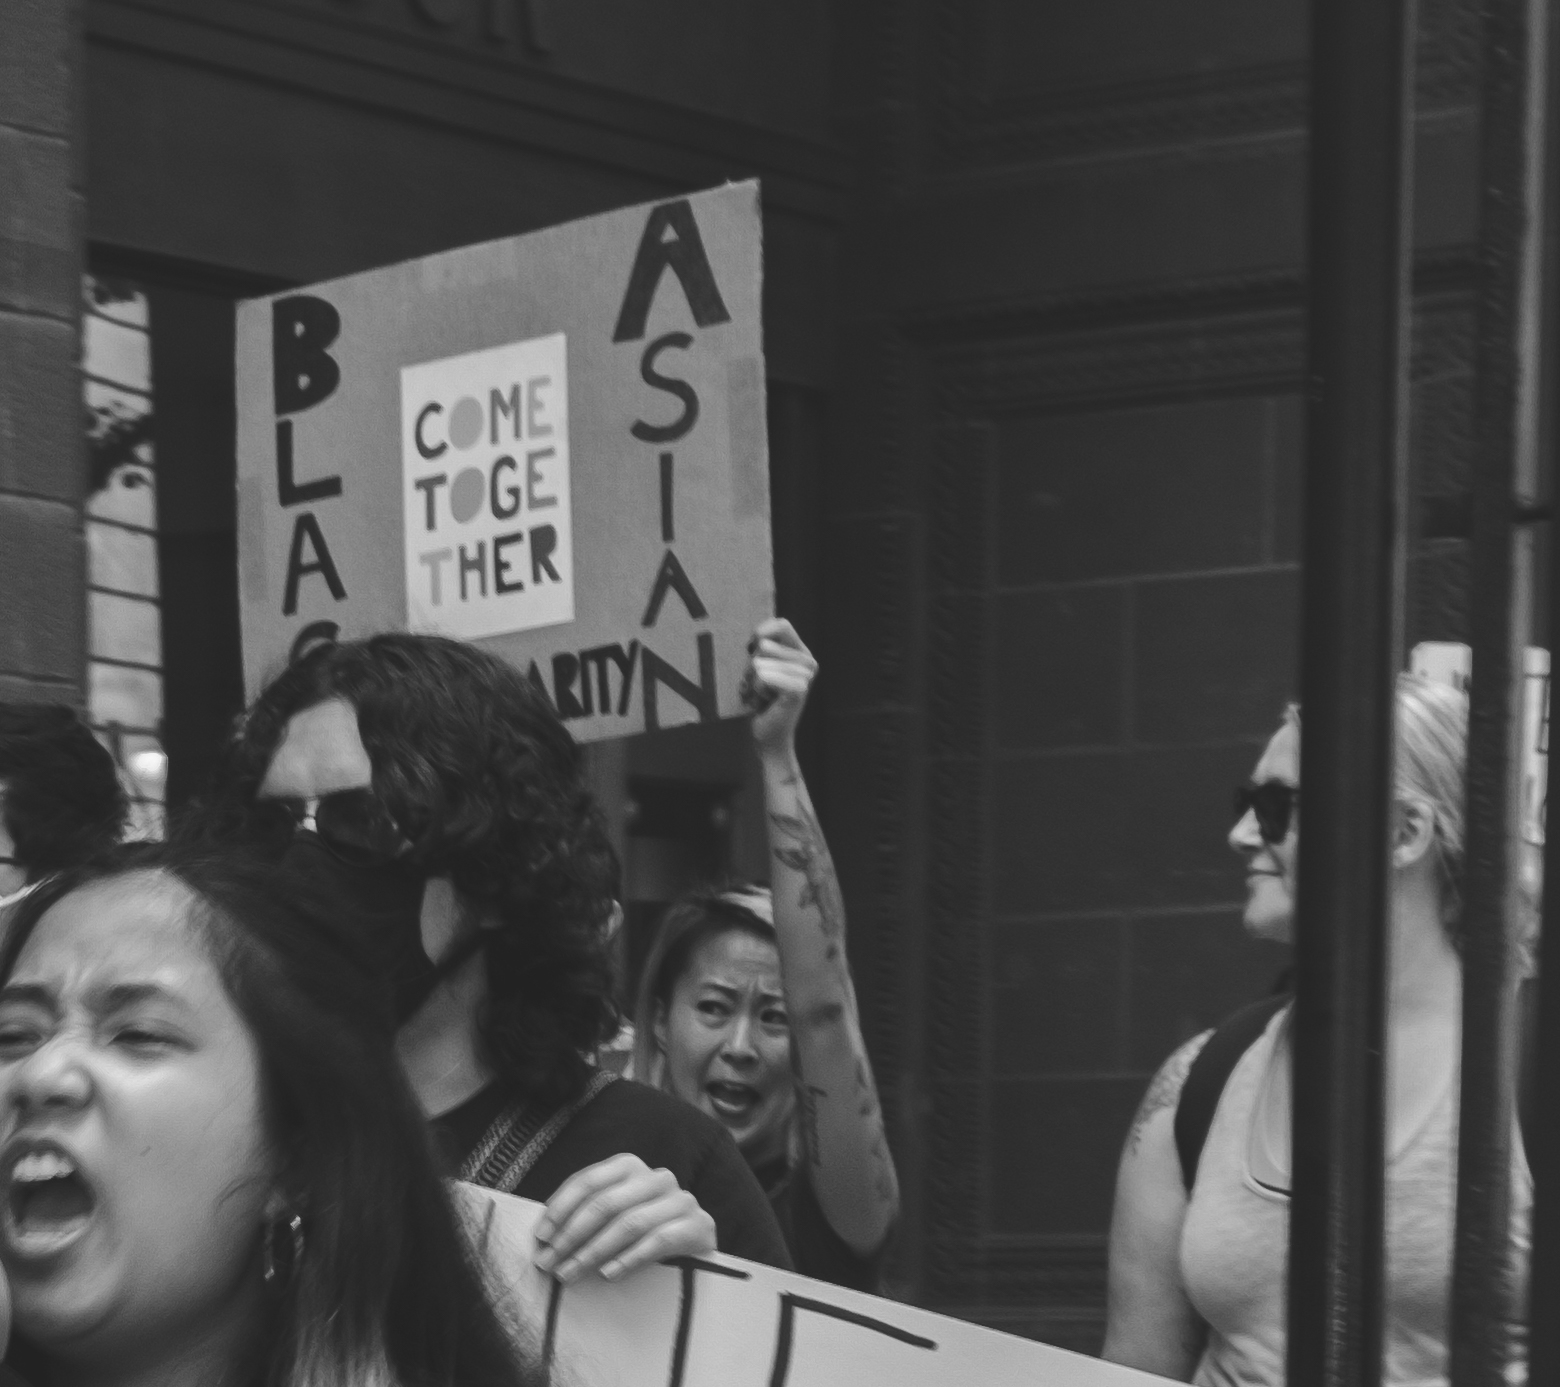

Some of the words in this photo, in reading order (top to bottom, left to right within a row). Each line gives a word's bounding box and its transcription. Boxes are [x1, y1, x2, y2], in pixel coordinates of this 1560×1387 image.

[414, 374, 554, 460] COME
[272, 295, 348, 660] BLA
[414, 447, 558, 532] TOGE
[419, 523, 563, 606] THER
